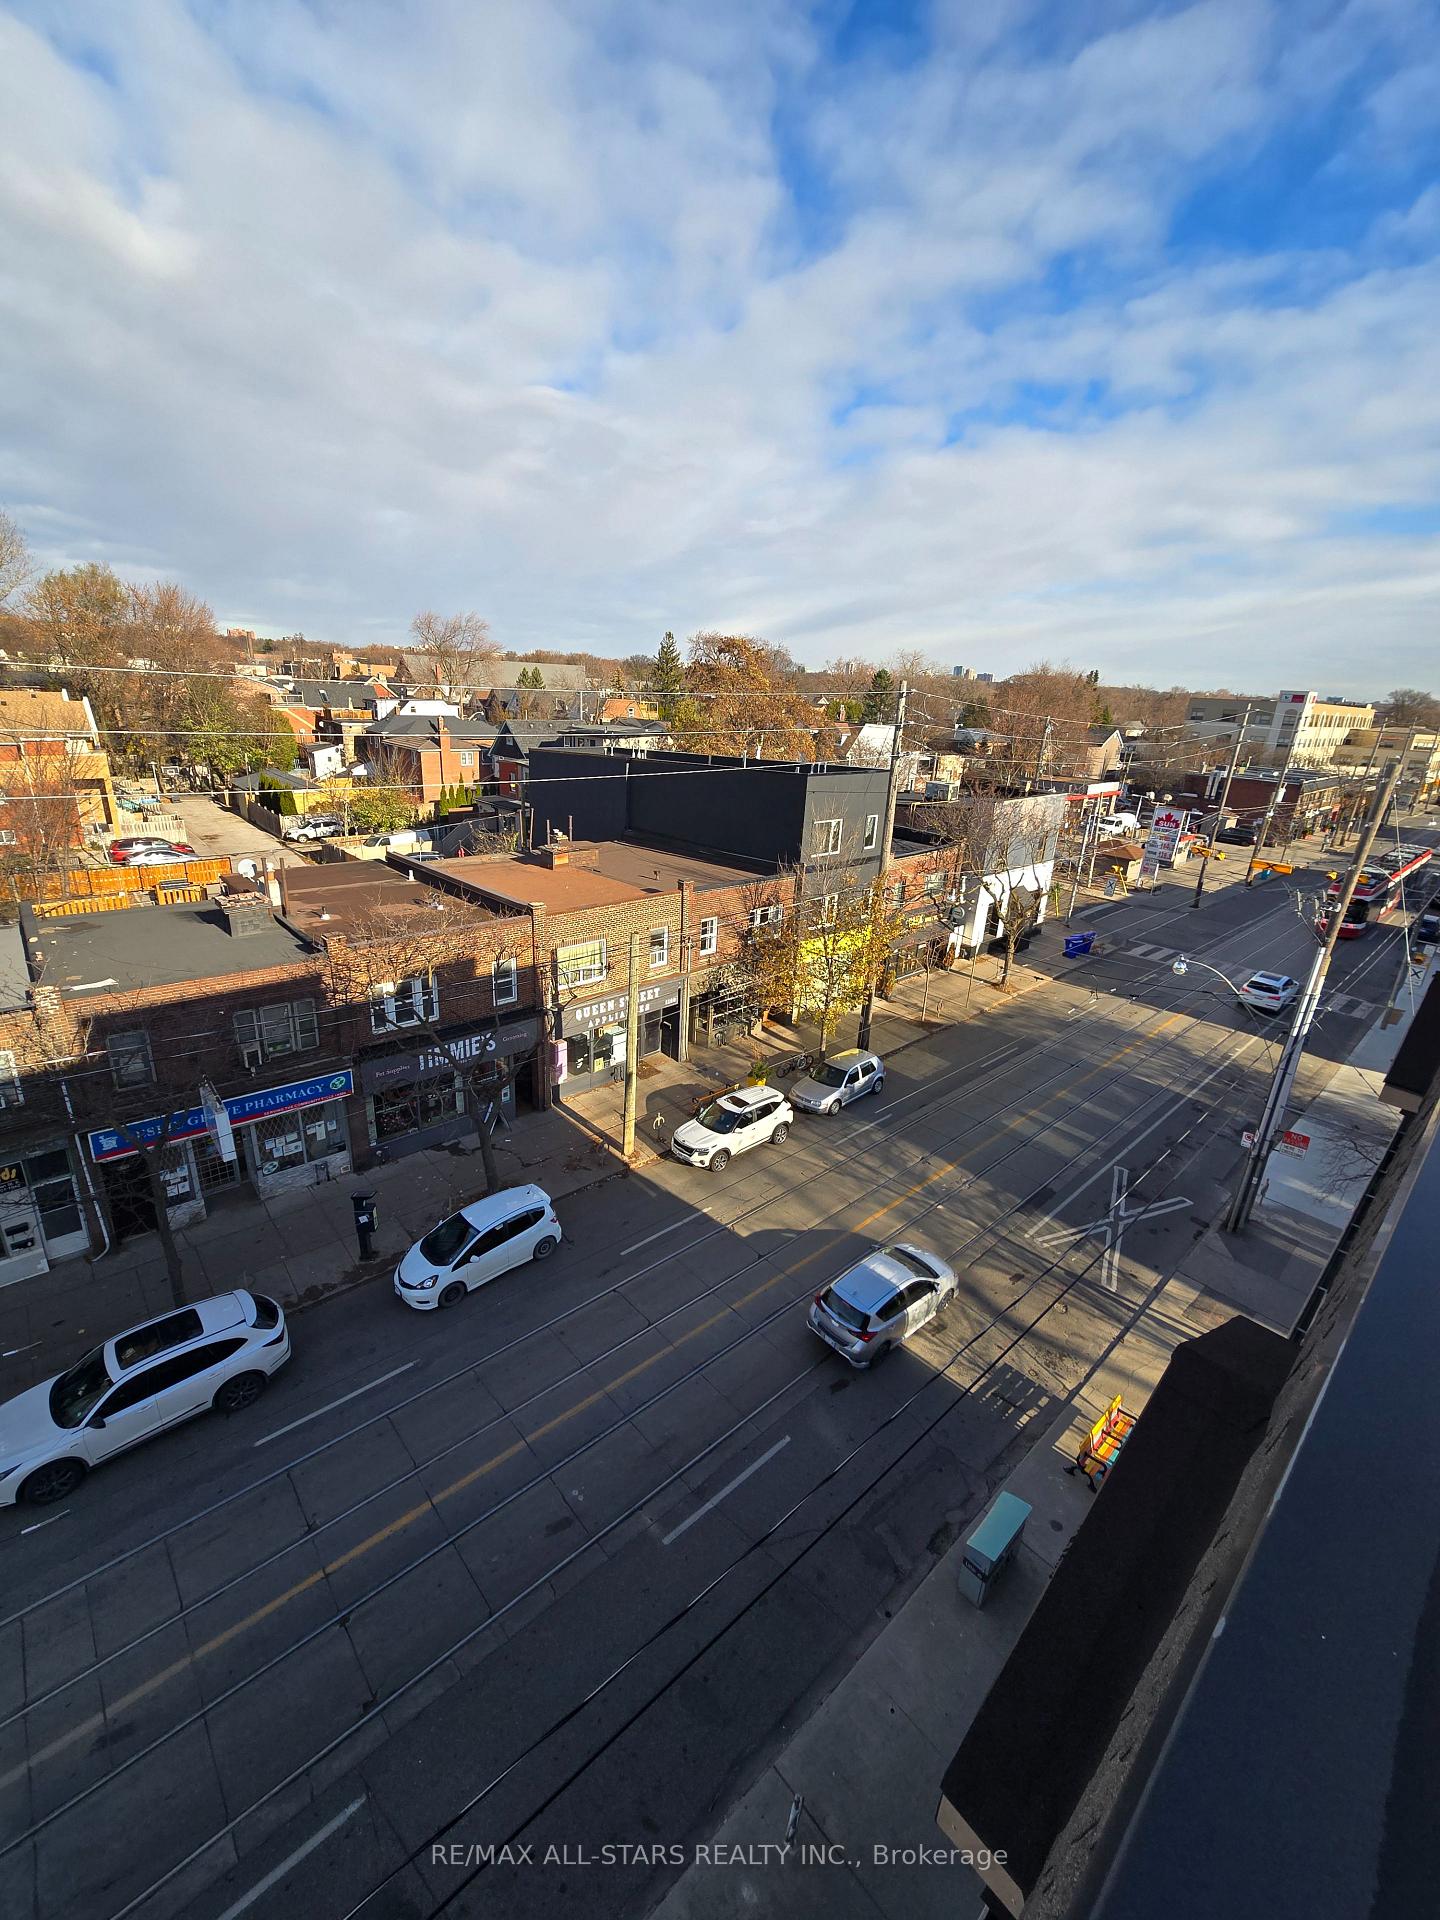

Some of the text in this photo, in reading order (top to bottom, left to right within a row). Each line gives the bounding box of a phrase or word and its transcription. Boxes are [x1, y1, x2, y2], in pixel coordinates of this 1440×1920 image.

[1158, 820, 1176, 828] SUN
[575, 987, 661, 1022] QUEEN SEET
[587, 1003, 651, 1029] APPLIAES
[245, 1083, 325, 1112] PHARMACY
[1291, 1133, 1303, 1141] NO
